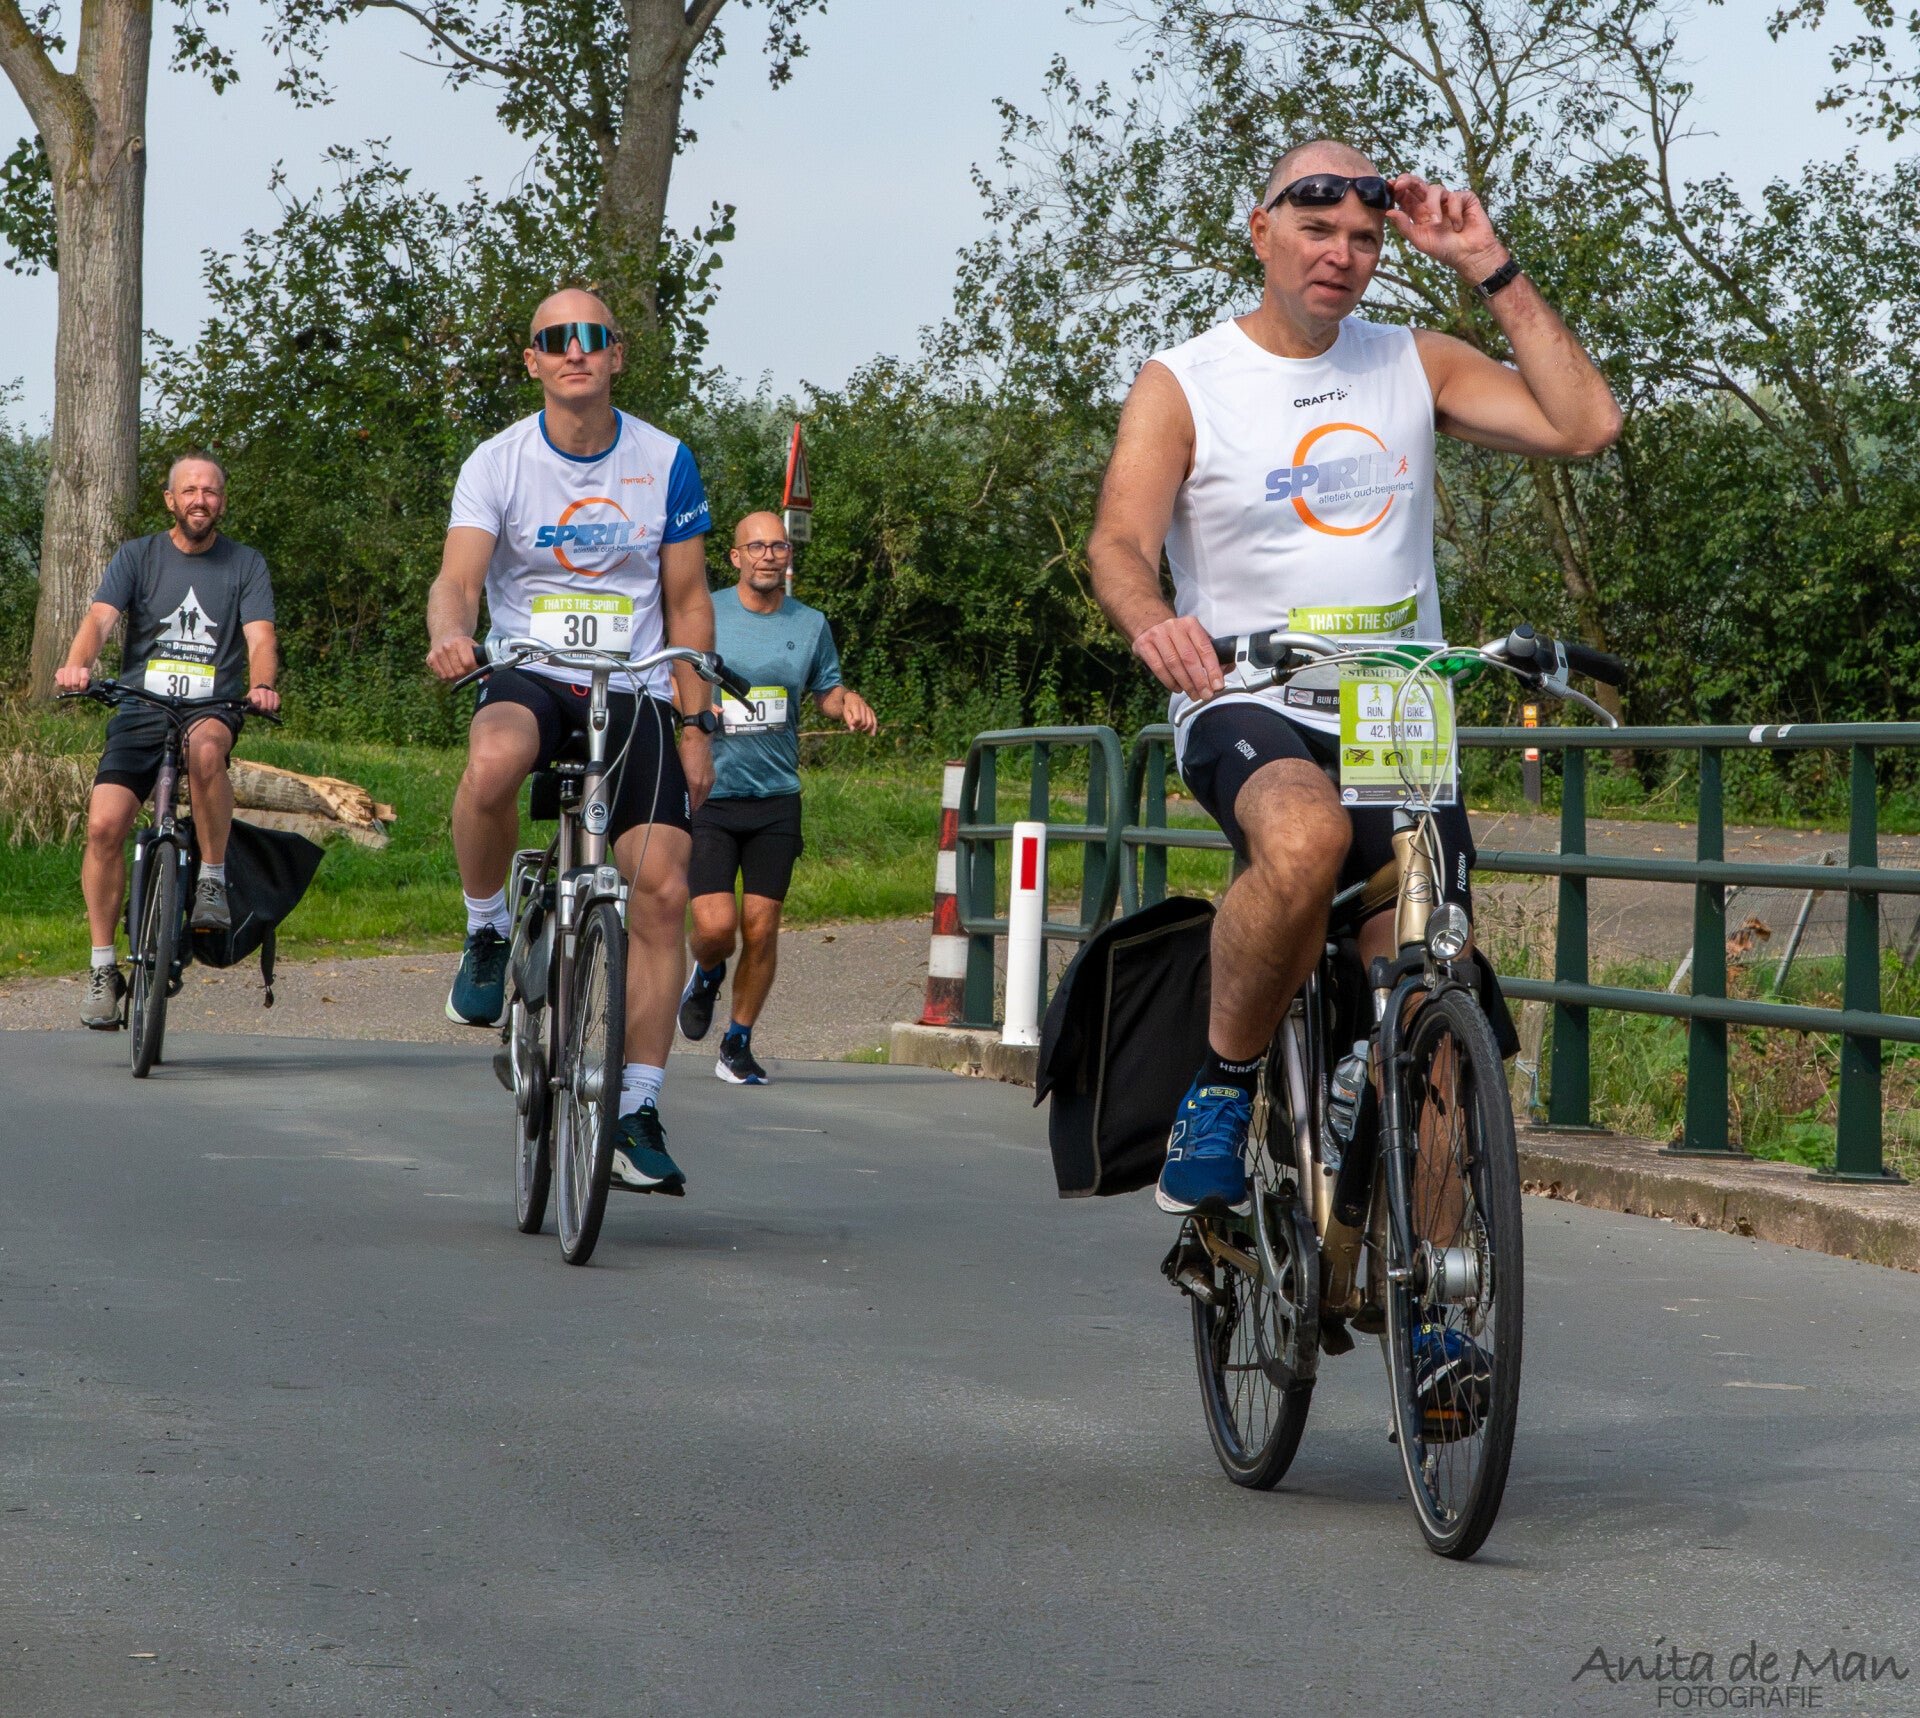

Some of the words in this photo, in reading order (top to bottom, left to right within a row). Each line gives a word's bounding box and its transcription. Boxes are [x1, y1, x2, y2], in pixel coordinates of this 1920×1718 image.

[1293, 391, 1336, 408] CRAFT
[1265, 451, 1394, 502] SPIRIT
[1318, 491, 1352, 505] atletiek
[1353, 481, 1414, 499] oud-beijerland
[534, 521, 636, 548] SPIRIT
[543, 598, 573, 611] THAT'S
[575, 599, 591, 611] THE
[592, 600, 619, 612] SPIRIT
[563, 614, 598, 648] 30
[1307, 612, 1354, 631] THAT'S
[1358, 613, 1381, 629] THE
[167, 674, 190, 697] 30
[1406, 724, 1423, 738] KM
[1457, 851, 1467, 892] FUSION
